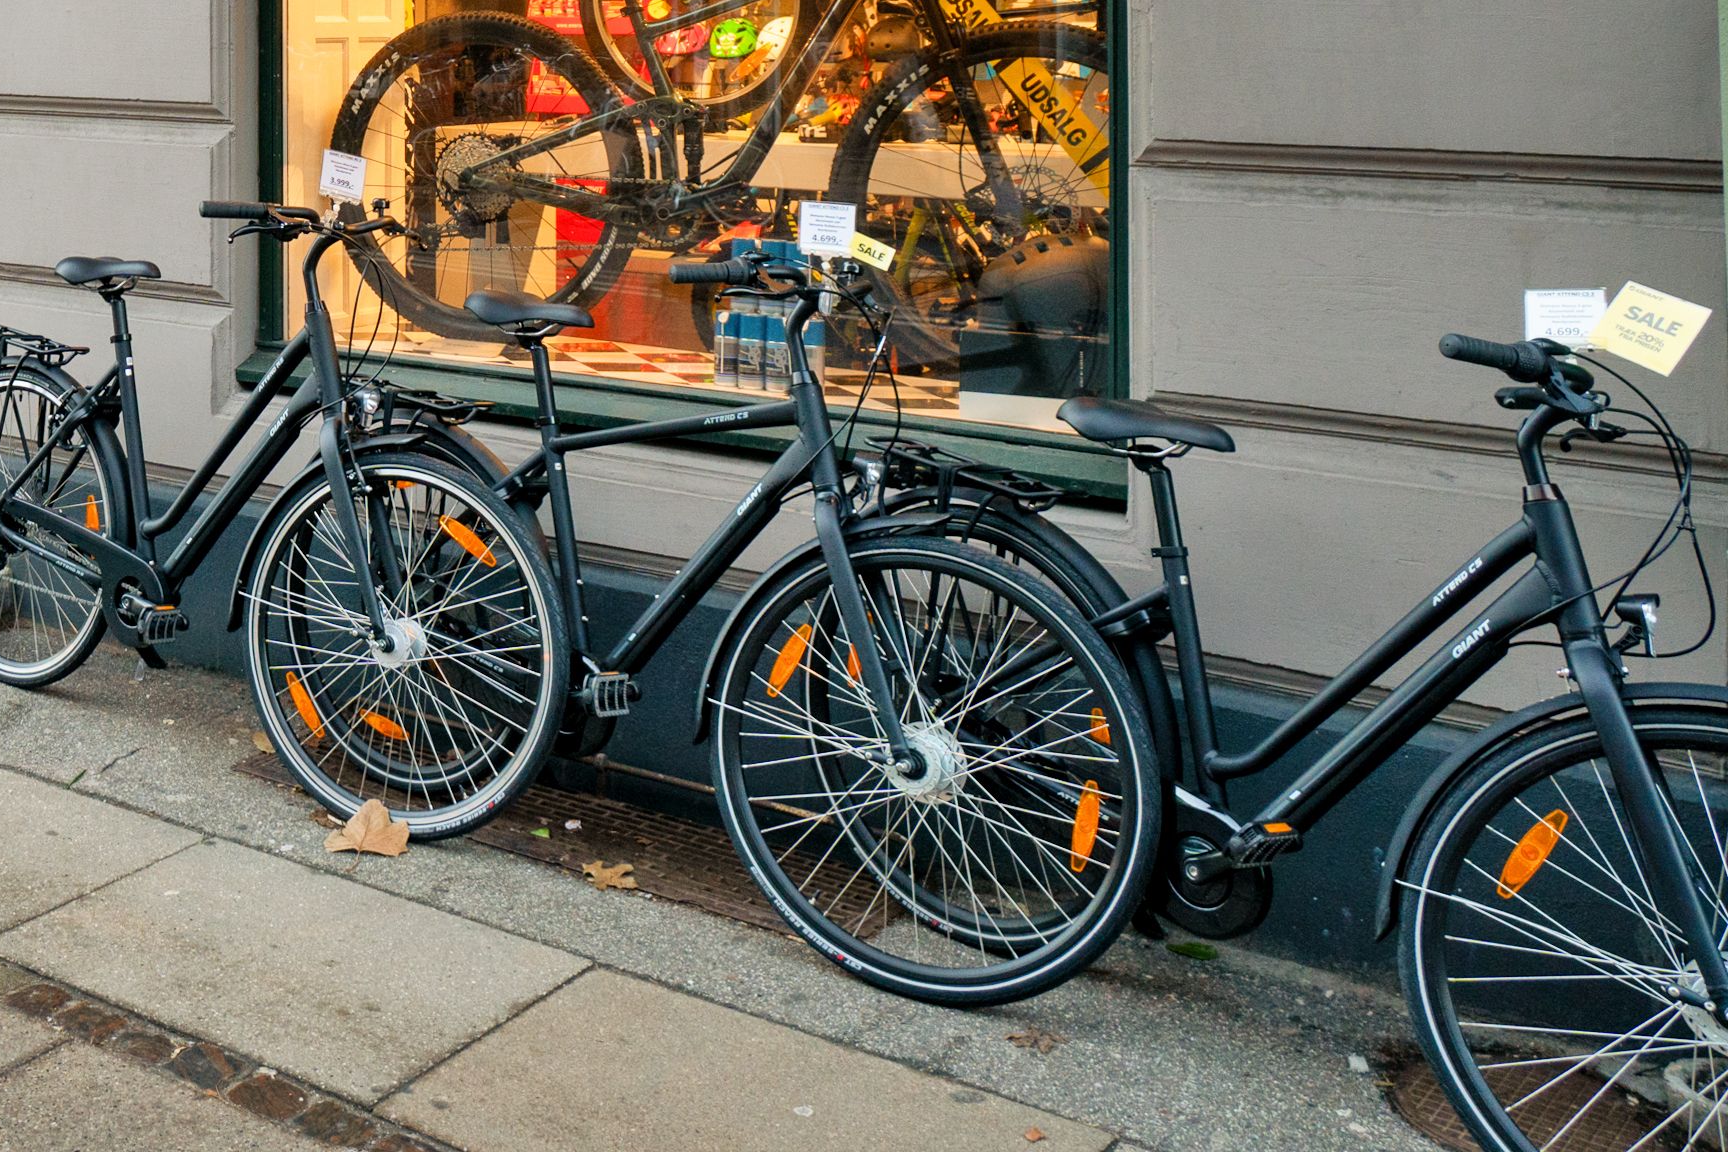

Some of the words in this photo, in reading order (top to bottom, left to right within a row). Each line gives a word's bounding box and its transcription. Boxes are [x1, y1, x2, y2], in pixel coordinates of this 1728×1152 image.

[351, 51, 401, 115] MAXXIS
[864, 64, 930, 135] MAXXIS
[1020, 73, 1087, 147] UDSALG
[857, 243, 886, 262] SALE
[1624, 306, 1683, 336] SALE
[1619, 333, 1634, 344] FRA
[1638, 330, 1665, 347] 20%
[269, 408, 289, 437] GIANT
[704, 413, 735, 425] ATTEND
[737, 411, 749, 419] CS
[736, 483, 762, 516] GIANT
[1432, 570, 1468, 606] ATTEND
[1468, 557, 1483, 574] CS
[1452, 618, 1490, 659] GIANT
[773, 899, 801, 928] REACH
[844, 957, 862, 971] CST
